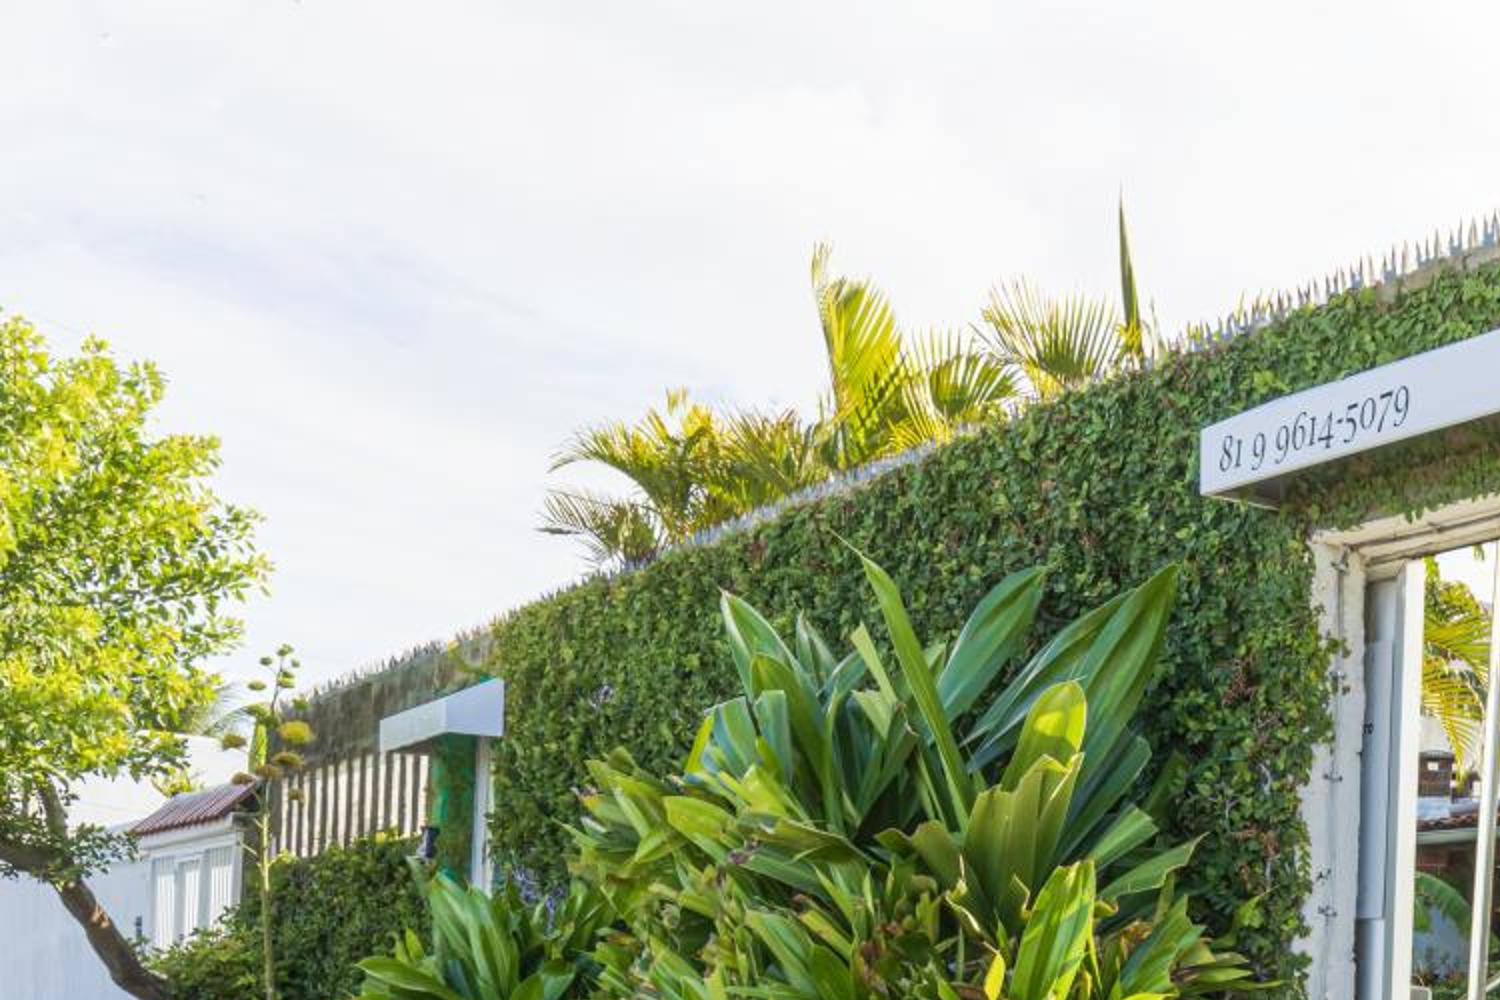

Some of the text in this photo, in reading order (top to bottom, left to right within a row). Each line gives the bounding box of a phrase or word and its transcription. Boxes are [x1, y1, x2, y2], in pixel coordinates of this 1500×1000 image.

[1219, 385, 1410, 472] 81 9 9614-5079
